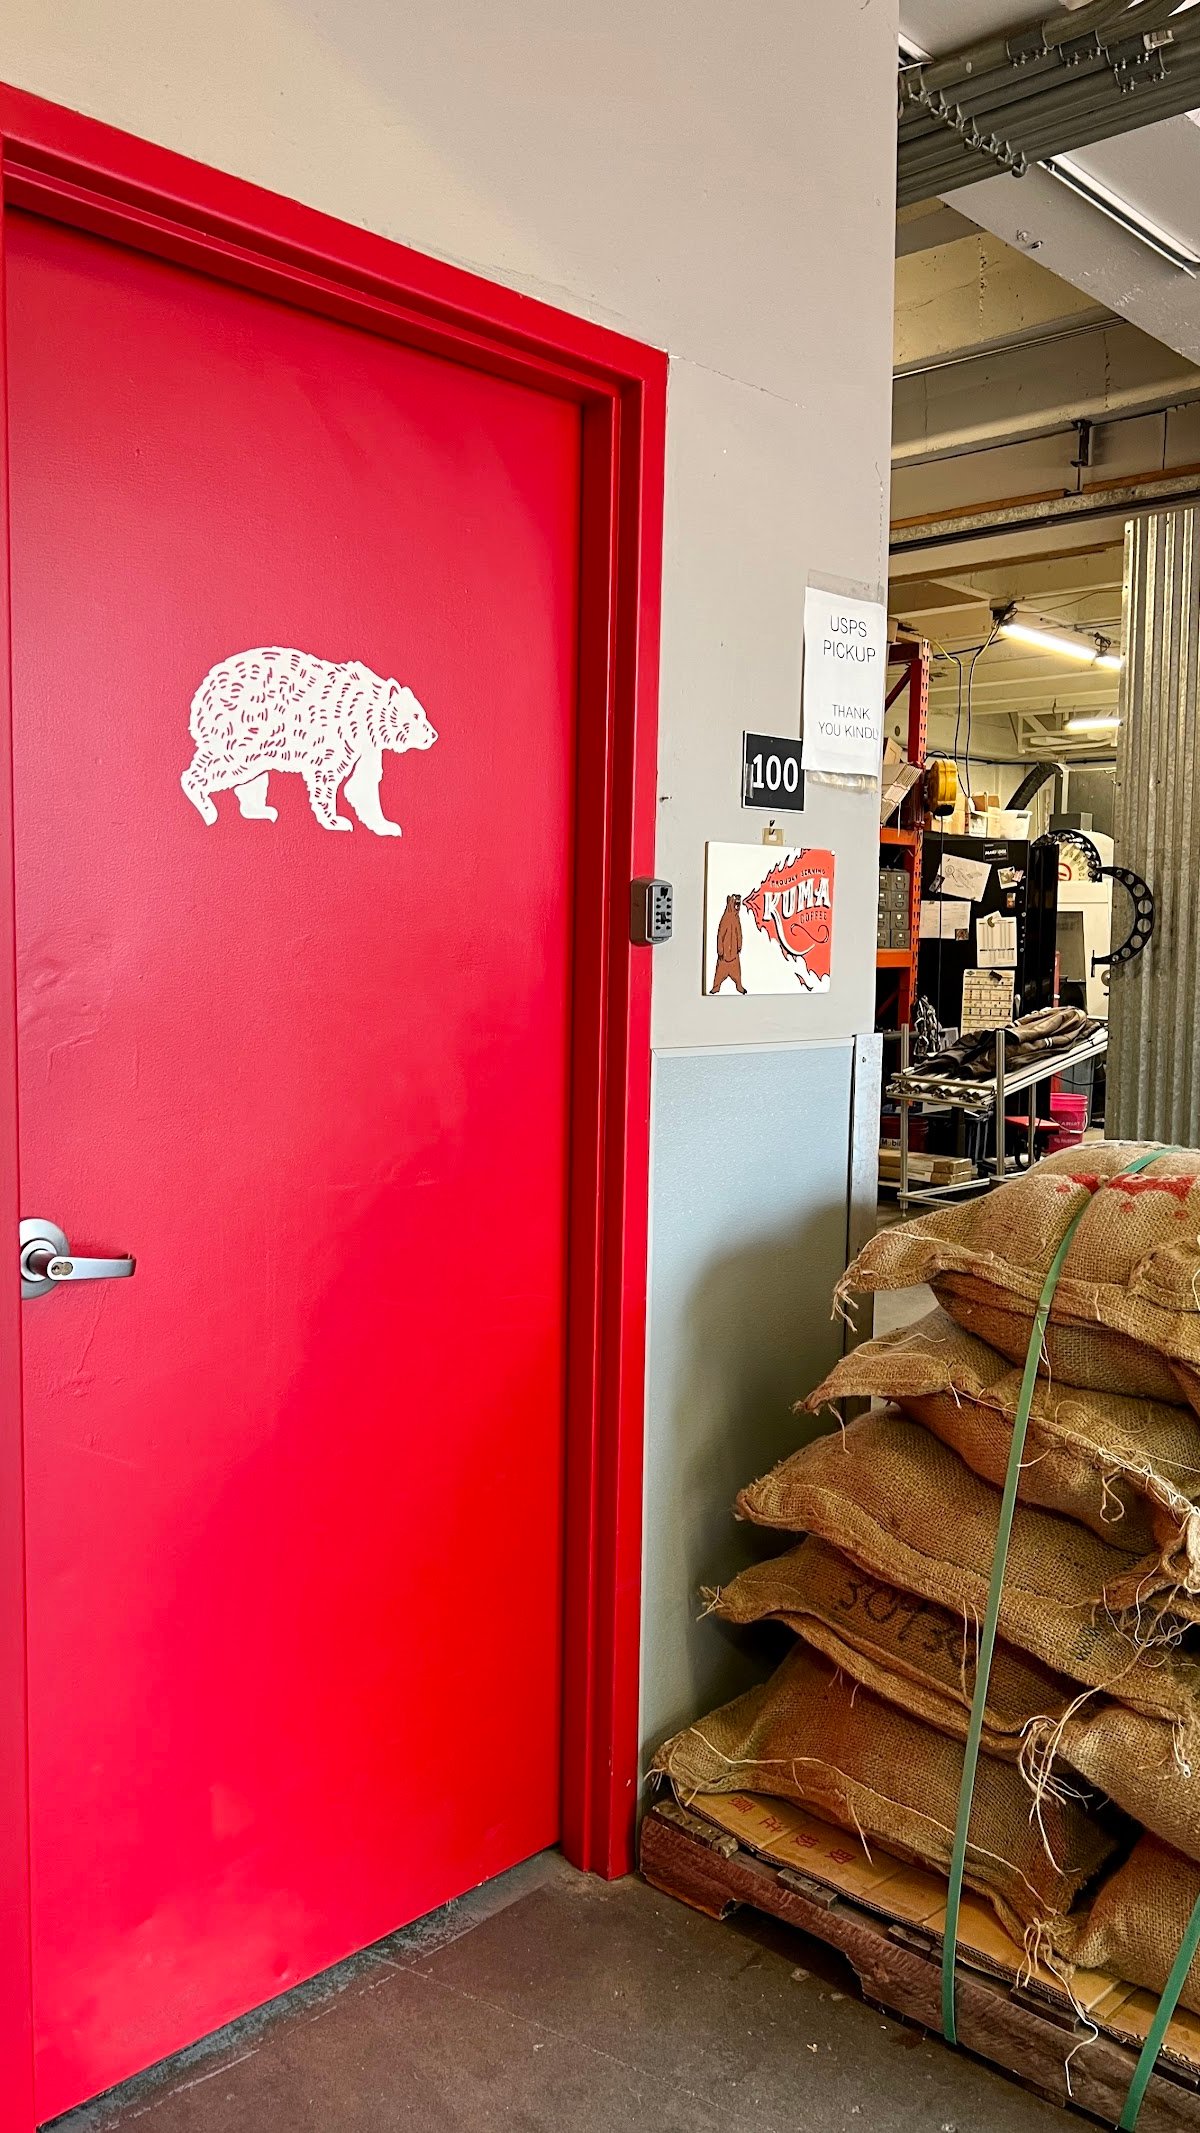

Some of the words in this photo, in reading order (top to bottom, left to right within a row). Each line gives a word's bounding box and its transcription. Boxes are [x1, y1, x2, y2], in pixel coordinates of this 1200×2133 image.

[830, 615, 867, 638] USPS
[823, 639, 876, 663] PICKUP
[832, 704, 871, 720] THANK
[818, 721, 841, 736] YOU
[752, 753, 799, 793] 100
[762, 877, 831, 948] KUMA
[800, 910, 827, 924] COFFEE
[727, 1795, 857, 1866] 取扱注意
